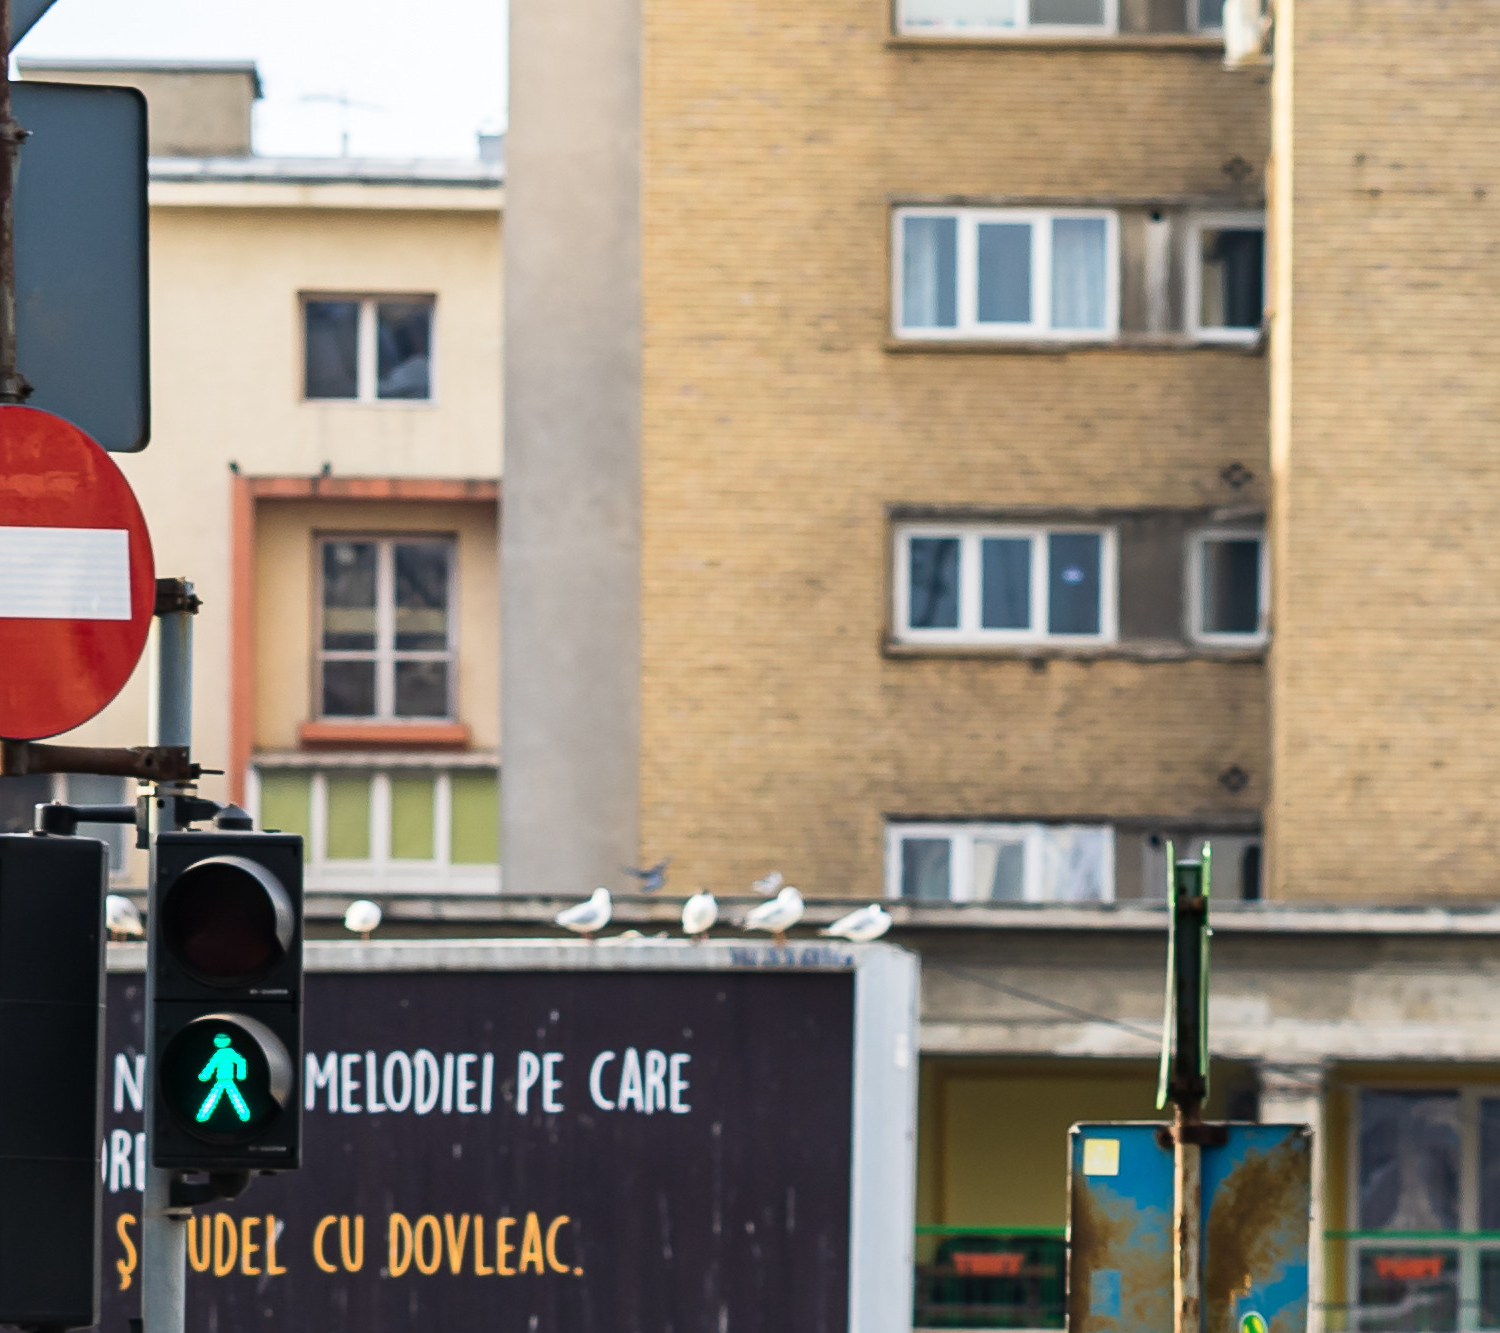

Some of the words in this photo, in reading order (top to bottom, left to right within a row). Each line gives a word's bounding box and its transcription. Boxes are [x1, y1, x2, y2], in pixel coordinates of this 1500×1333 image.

[304, 1047, 495, 1115] MELODIEI
[516, 1050, 565, 1115] PE
[588, 1046, 692, 1115] CARE
[312, 1213, 365, 1274] CU
[388, 1210, 585, 1278] DOVLEAC.
